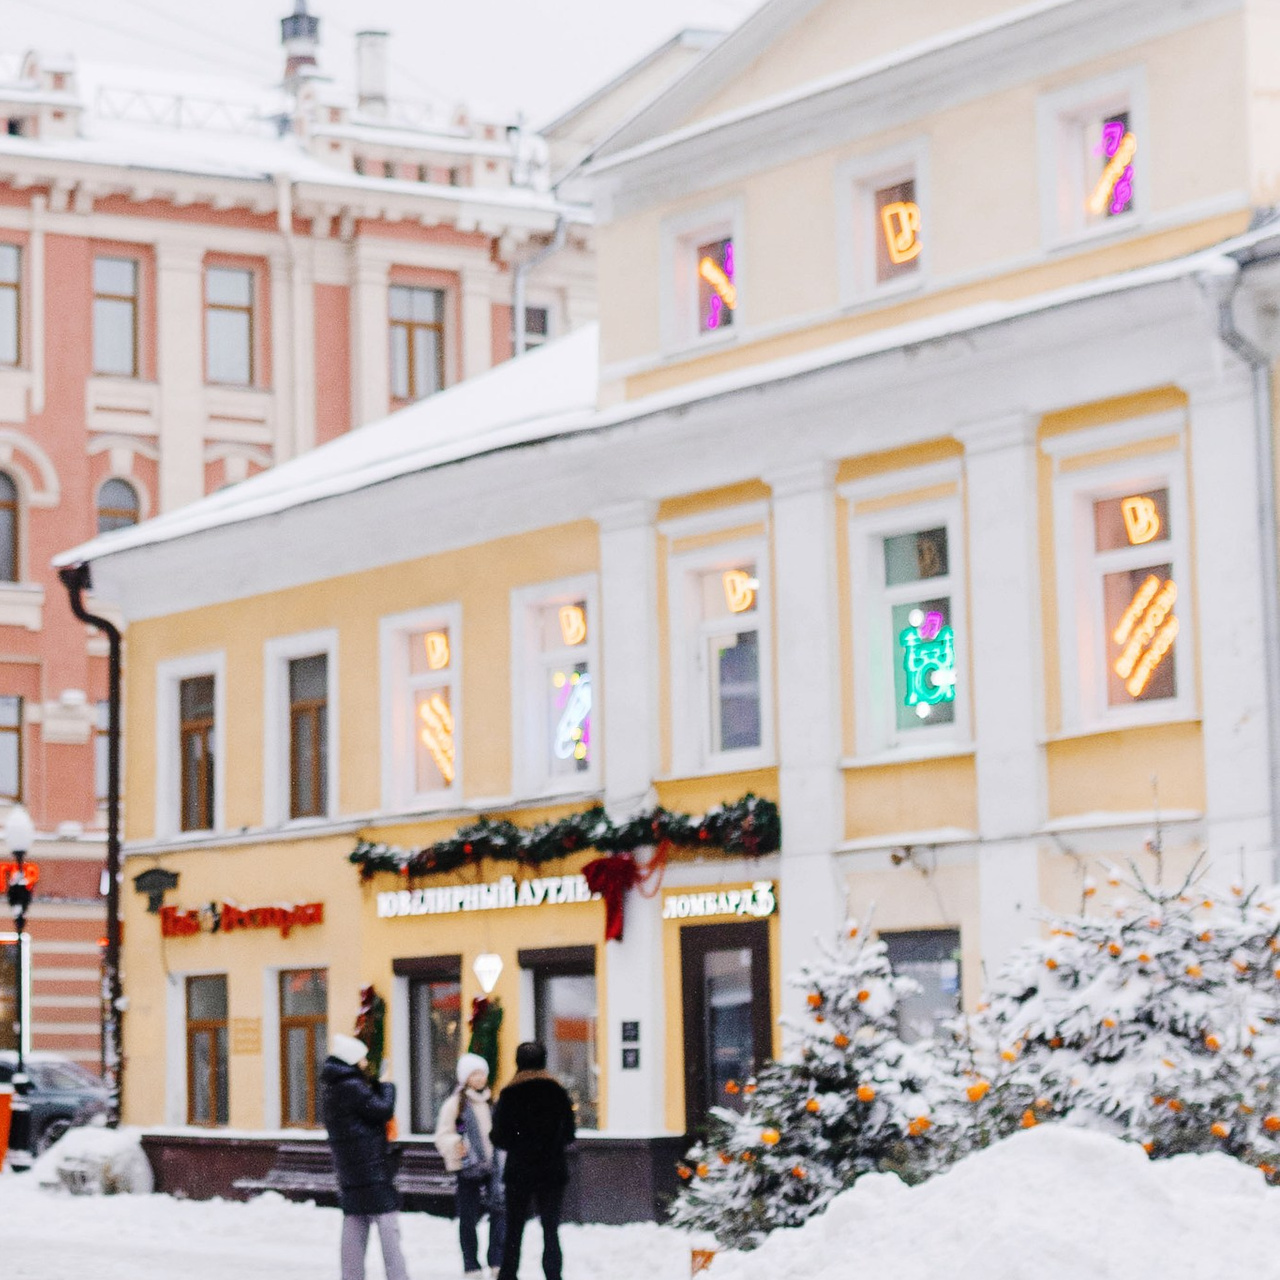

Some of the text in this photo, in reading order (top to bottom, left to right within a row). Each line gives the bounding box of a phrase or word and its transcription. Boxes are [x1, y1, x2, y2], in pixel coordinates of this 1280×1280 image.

[376, 873, 602, 918] ЮВЕЛИРНЫЙ АУТЛЕ
[662, 888, 757, 919] ЛОМБАРД
